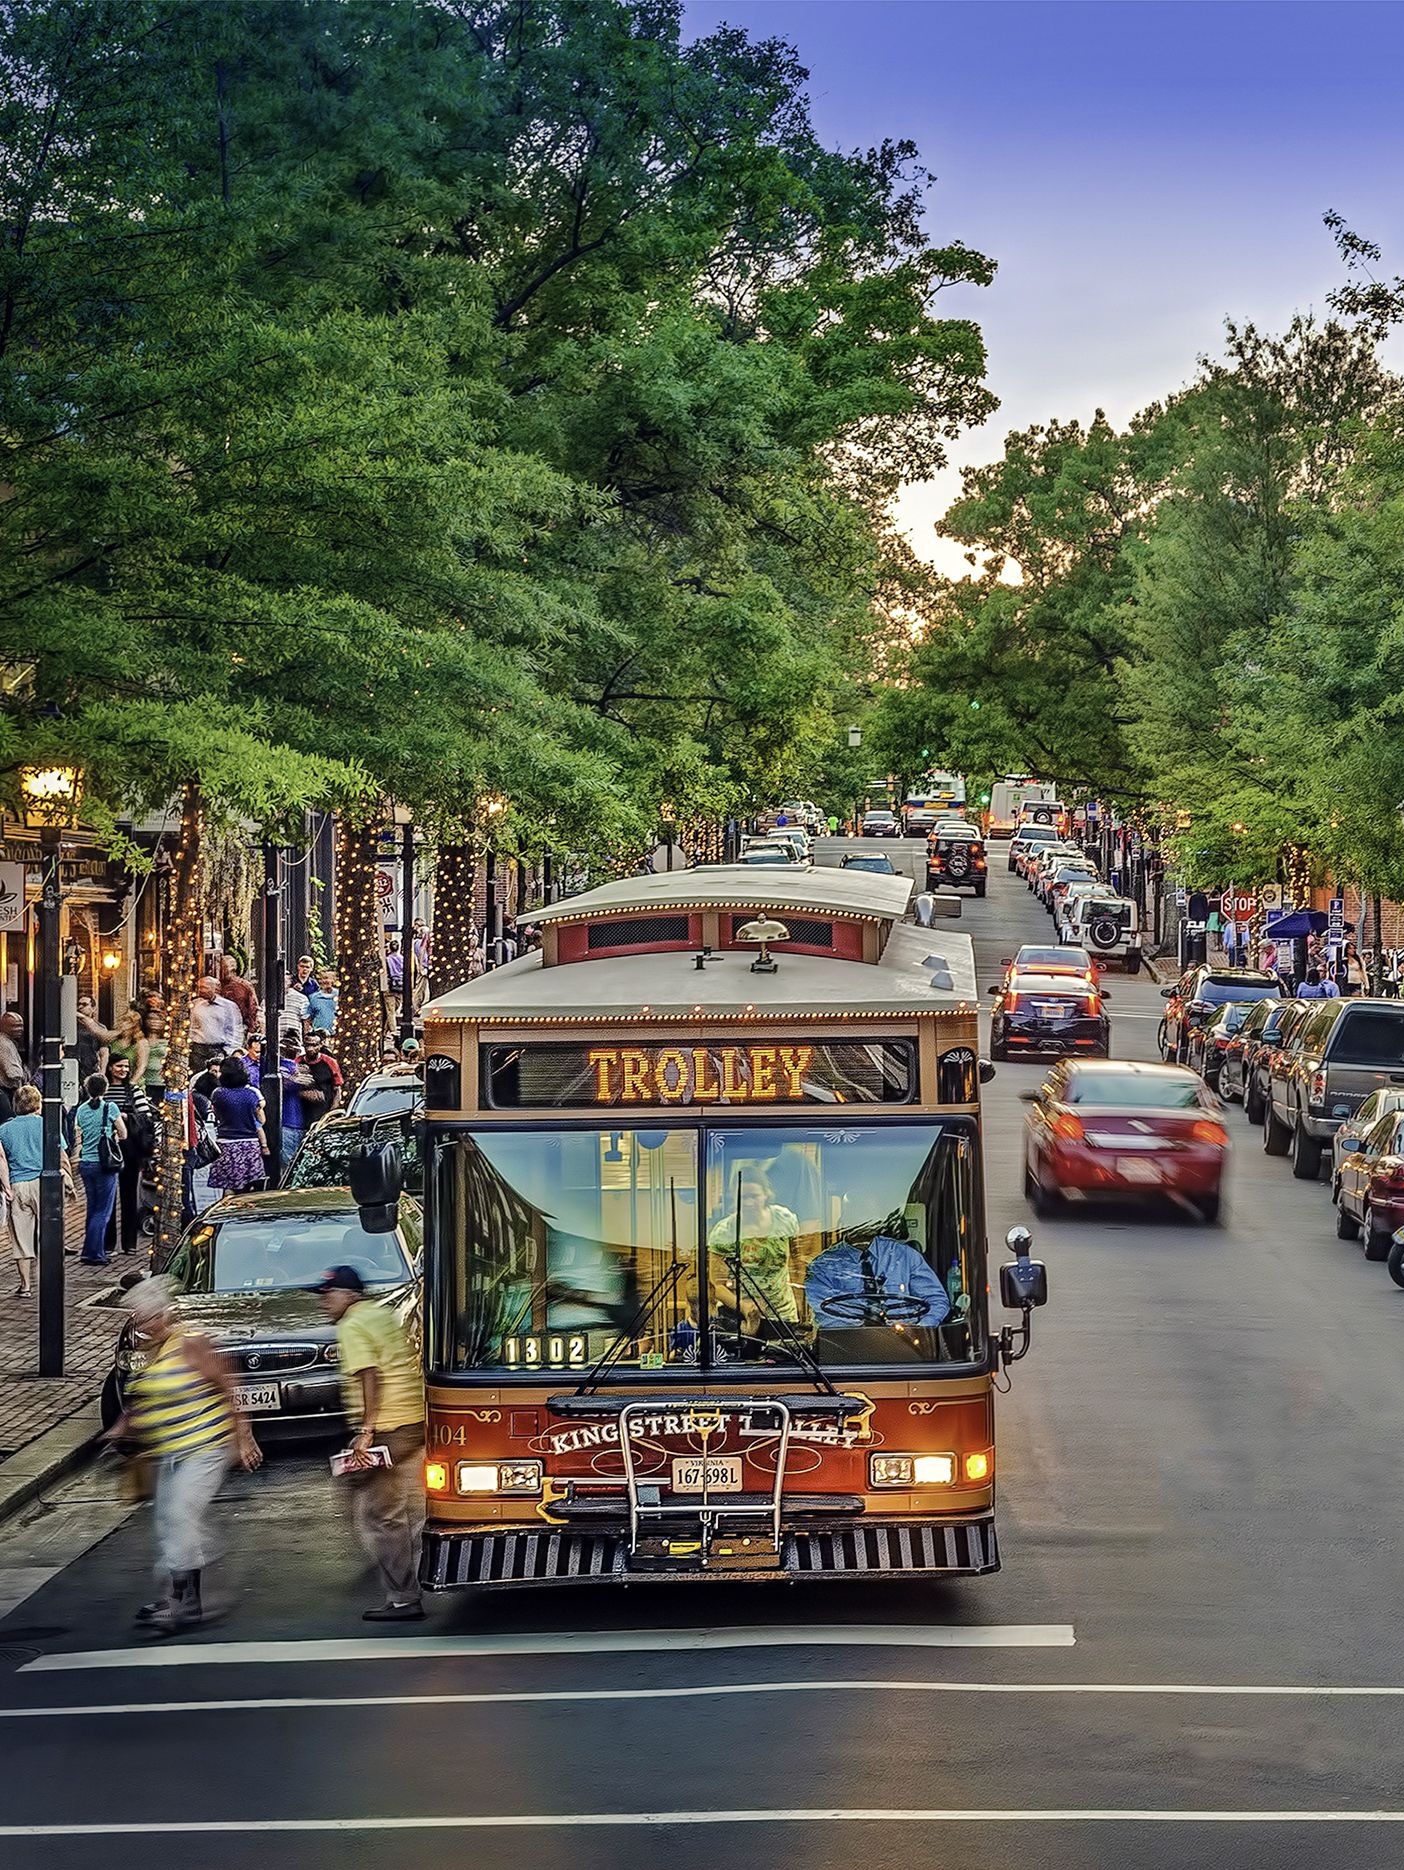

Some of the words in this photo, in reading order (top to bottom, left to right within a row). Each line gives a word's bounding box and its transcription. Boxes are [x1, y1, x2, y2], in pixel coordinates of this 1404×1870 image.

[1224, 897, 1257, 911] STOP
[589, 1048, 812, 1100] TROLLEY
[507, 1337, 584, 1362] 1302
[251, 1391, 276, 1404] 5424
[551, 1423, 619, 1455] KING
[678, 1468, 738, 1485] 167-698L
